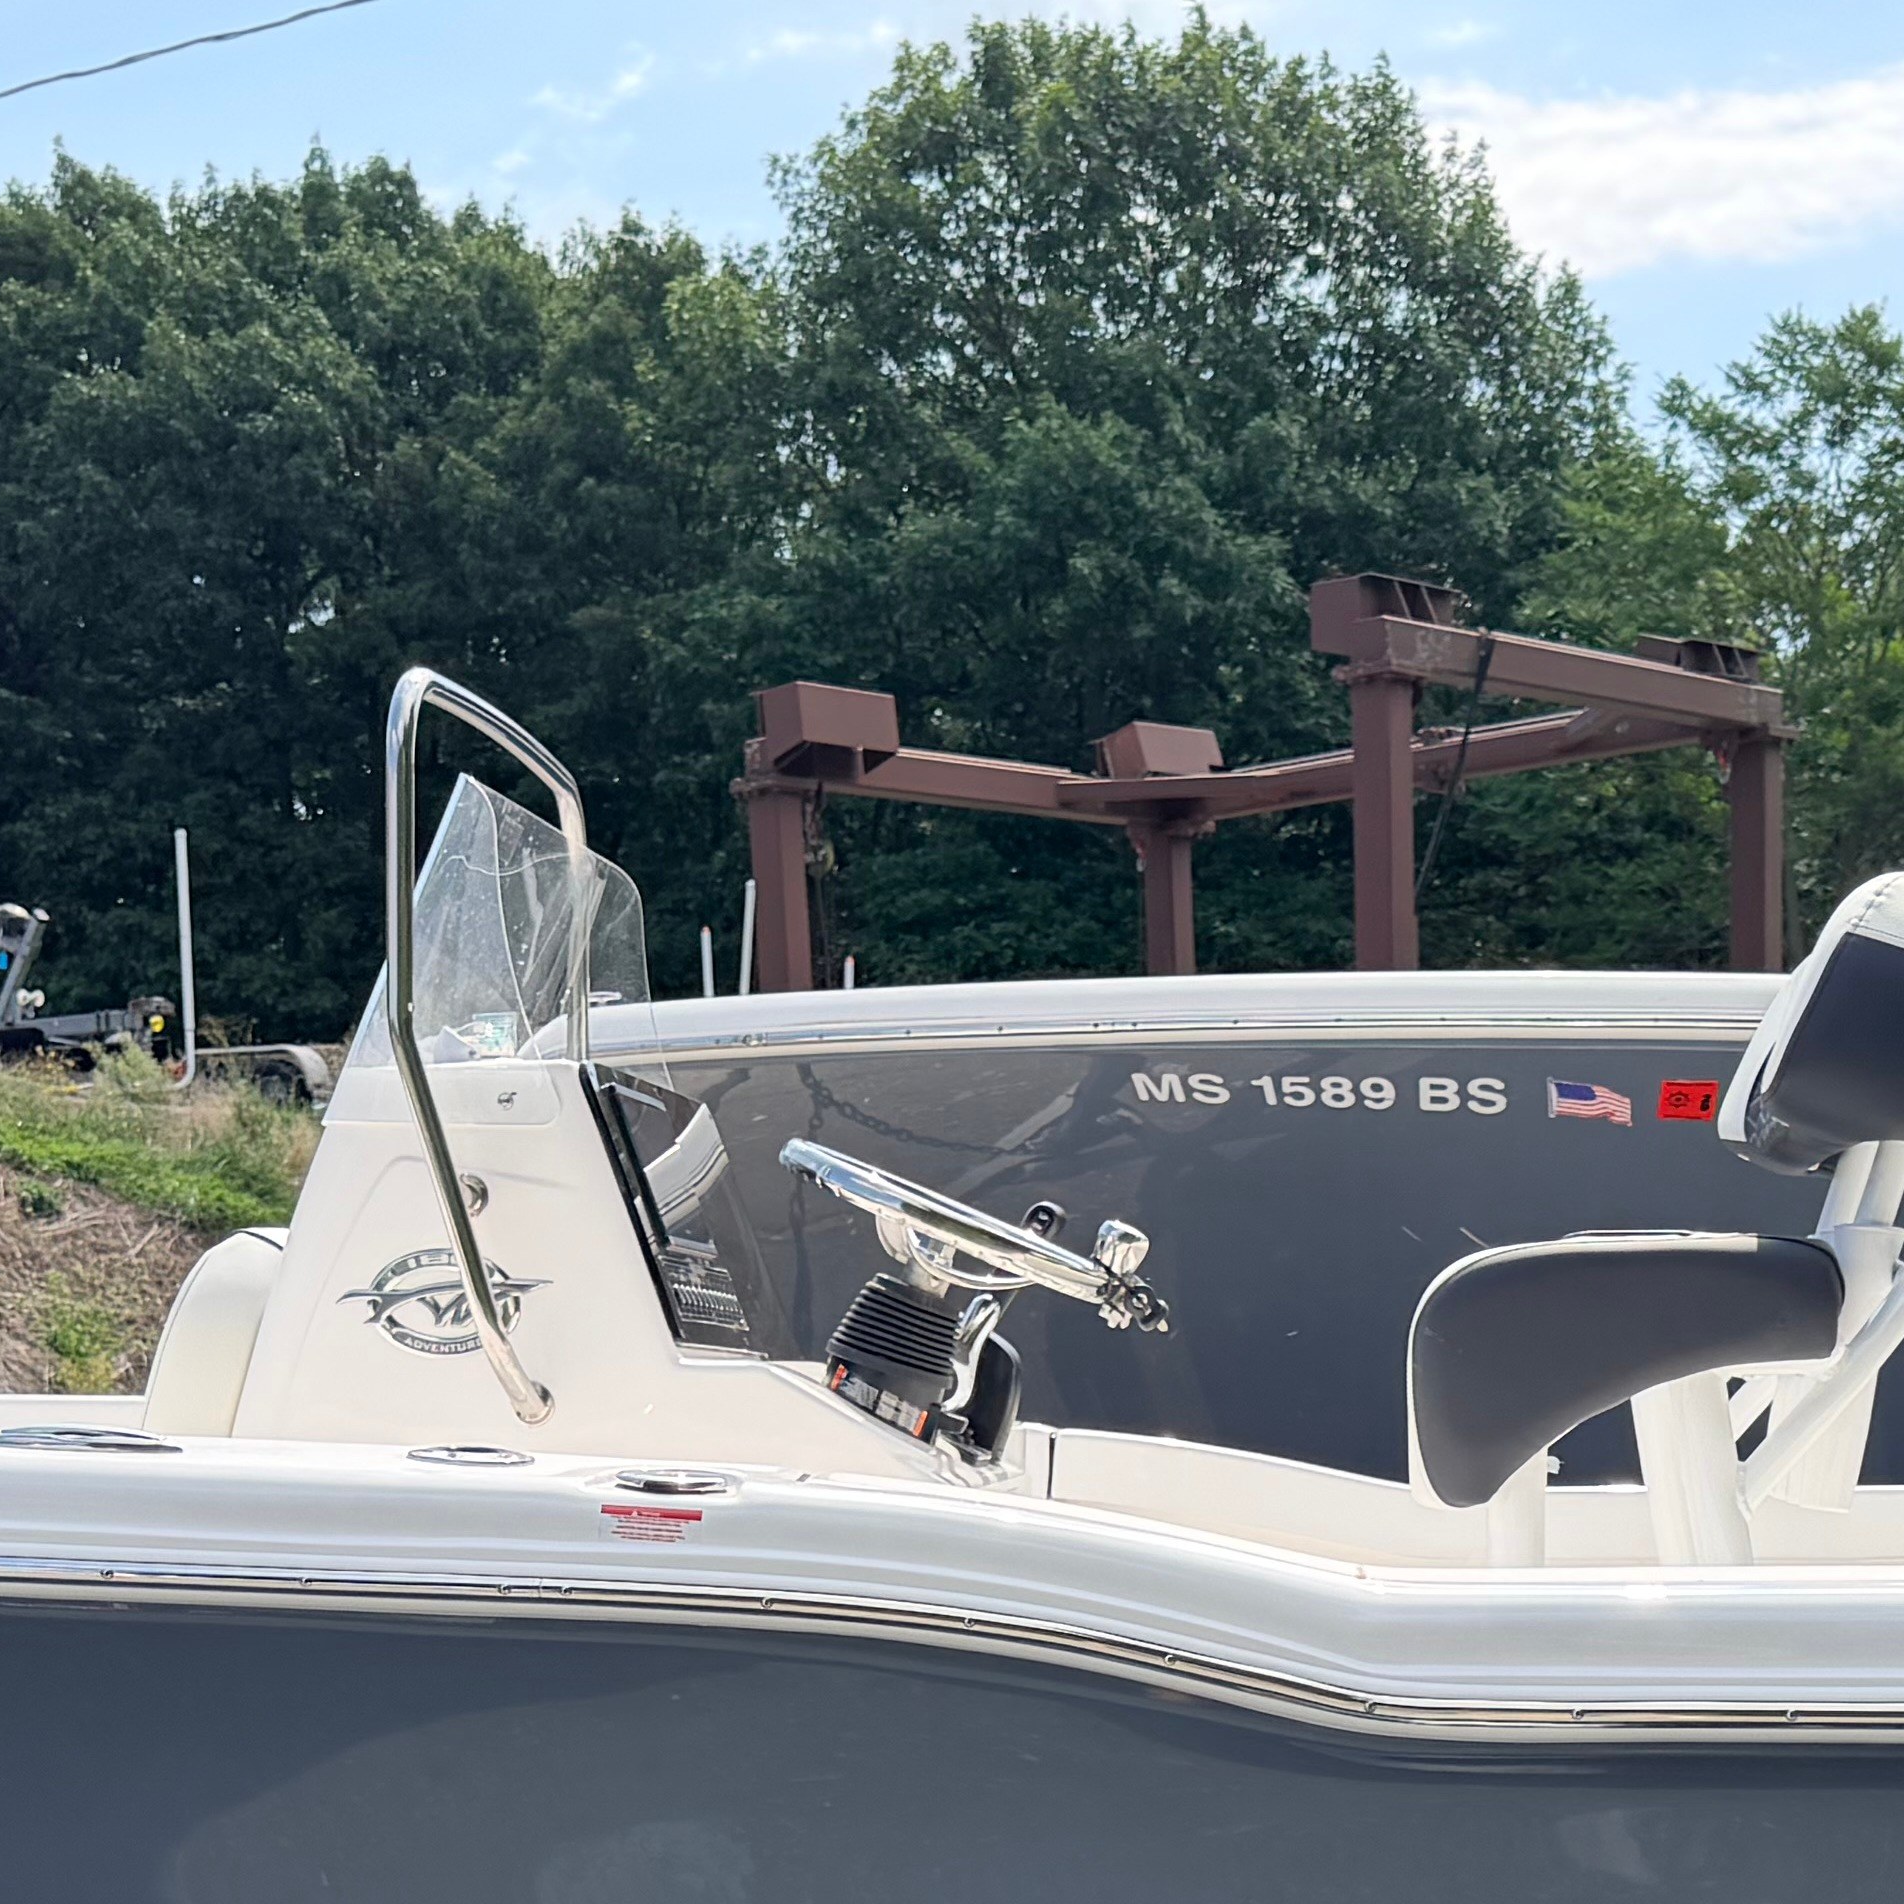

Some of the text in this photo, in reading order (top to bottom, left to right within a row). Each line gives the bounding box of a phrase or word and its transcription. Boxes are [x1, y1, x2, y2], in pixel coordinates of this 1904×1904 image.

[1131, 1073, 1508, 1115] MS 1589 BS
